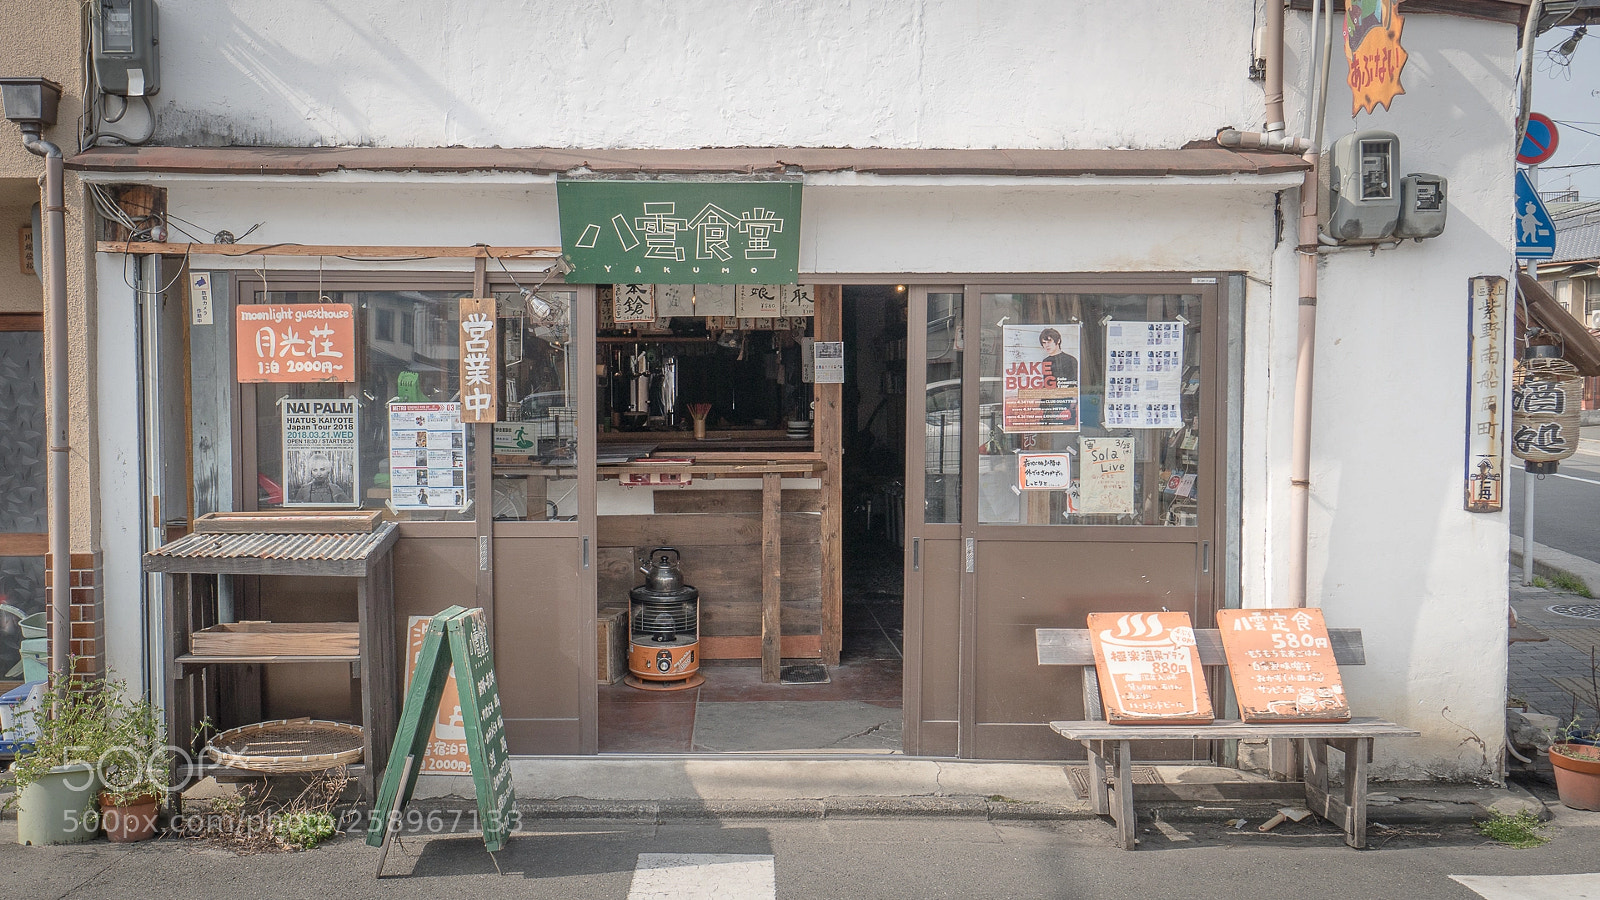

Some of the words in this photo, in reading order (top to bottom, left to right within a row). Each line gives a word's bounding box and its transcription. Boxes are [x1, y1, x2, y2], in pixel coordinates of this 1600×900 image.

[1351, 47, 1399, 92] あぶない
[575, 202, 784, 262] 八雲食堂
[604, 265, 758, 274] YAKUMO
[241, 307, 294, 323] moonlight
[295, 307, 349, 323] guesthouse
[255, 322, 343, 358] 月光荘
[258, 360, 280, 374] 1泊
[462, 313, 493, 420] 営業中
[1005, 361, 1052, 376] JAKE
[1005, 376, 1057, 390] BUGG
[287, 403, 310, 413] NAI
[314, 403, 353, 413] PALM
[1092, 448, 1118, 461] Sola
[1101, 464, 1125, 472] Live
[1234, 611, 1313, 632] 八雲定食
[1271, 633, 1328, 649] 580円
[1110, 650, 1185, 662] 極楽温泉プラン
[1152, 662, 1187, 673] 880円
